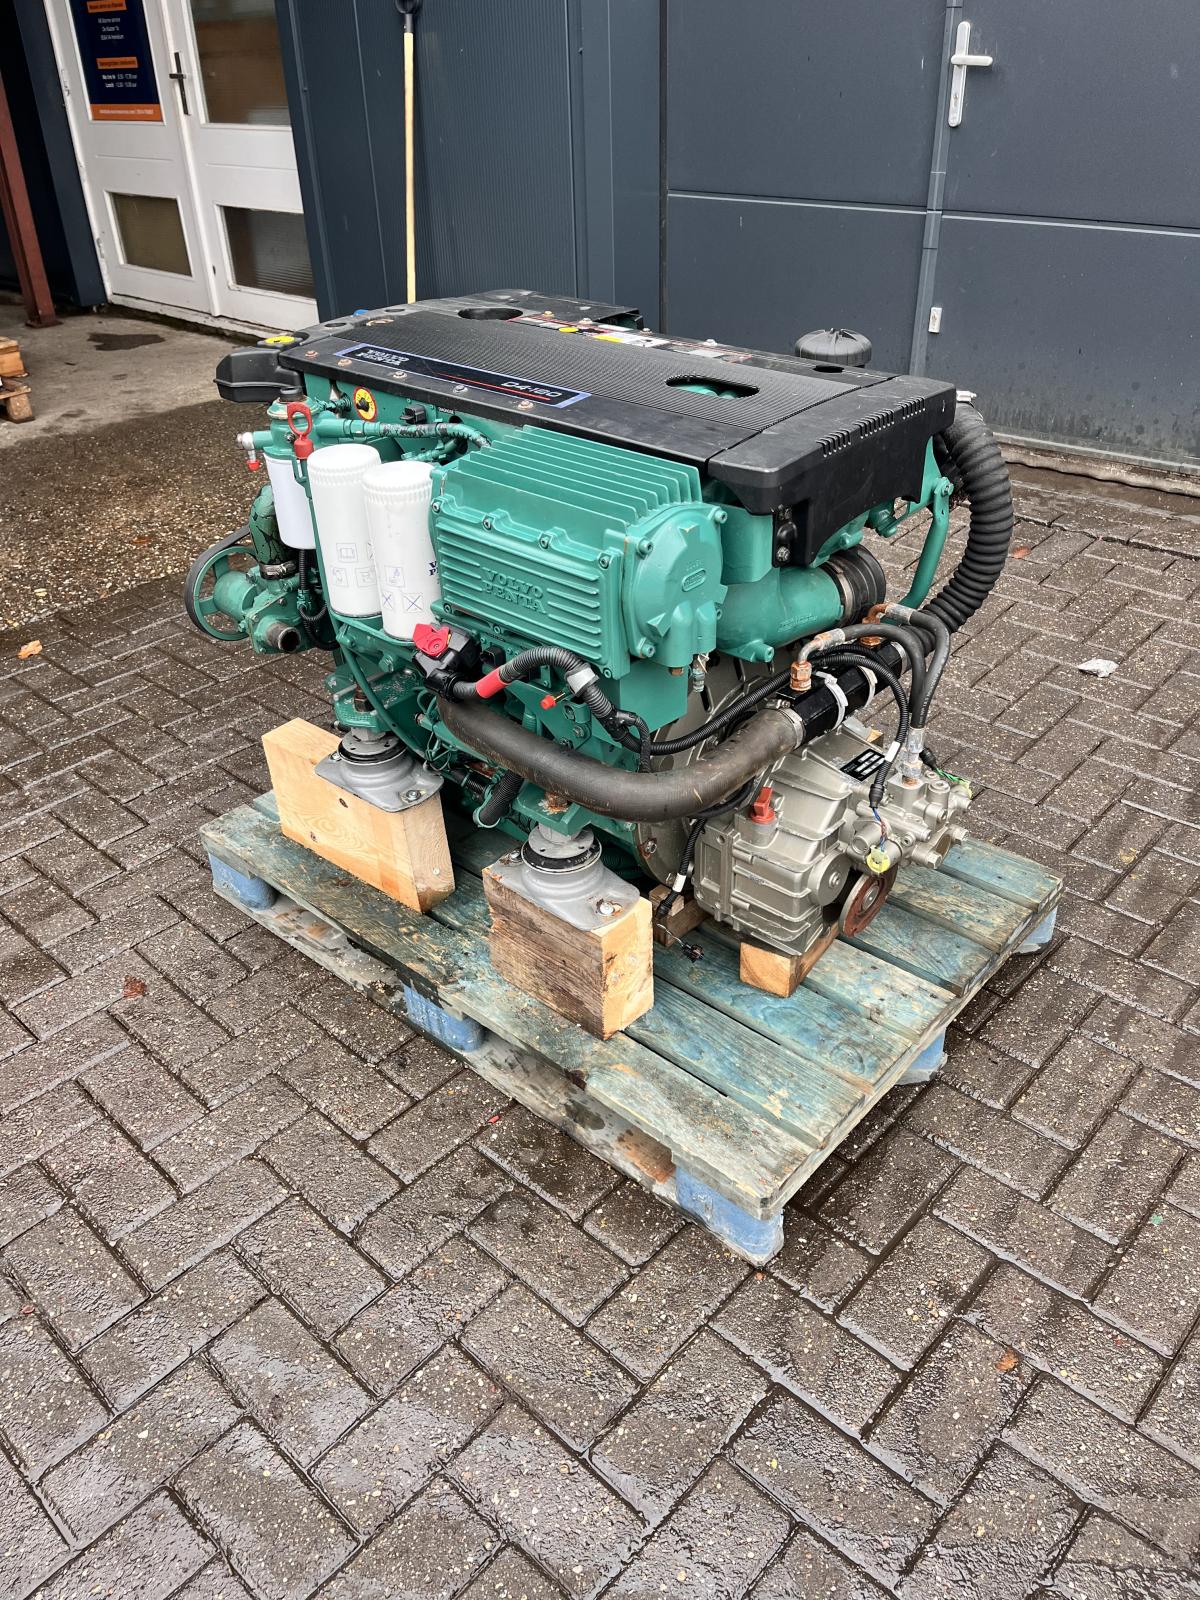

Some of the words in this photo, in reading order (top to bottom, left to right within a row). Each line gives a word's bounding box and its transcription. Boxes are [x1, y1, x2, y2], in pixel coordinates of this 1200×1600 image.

[501, 381, 562, 398] D4-180
[482, 566, 544, 599] VOLVO
[482, 579, 547, 615] PENTA
